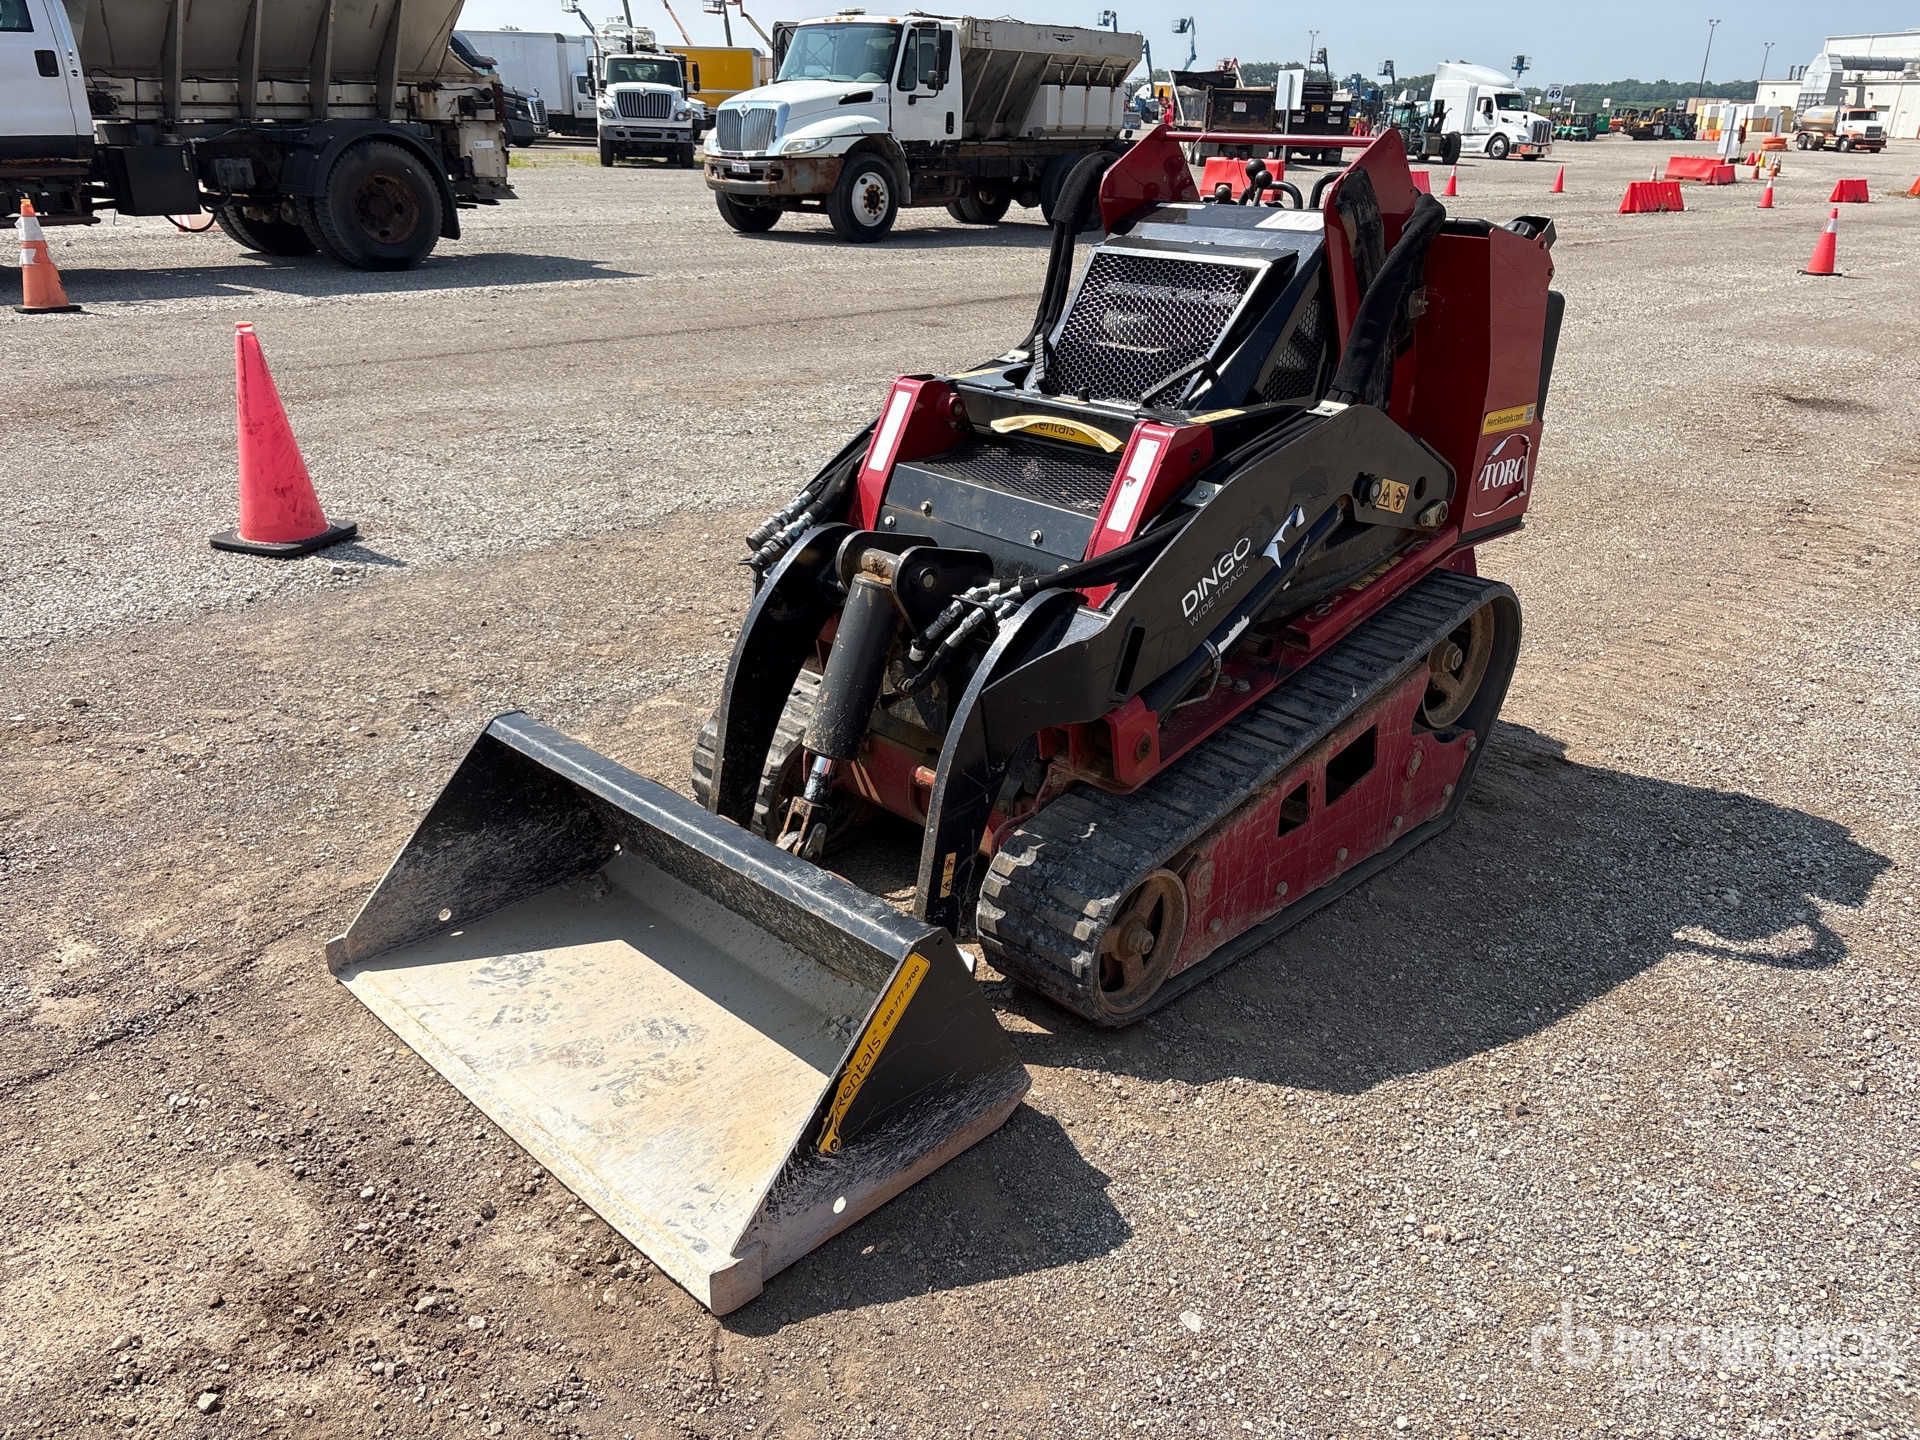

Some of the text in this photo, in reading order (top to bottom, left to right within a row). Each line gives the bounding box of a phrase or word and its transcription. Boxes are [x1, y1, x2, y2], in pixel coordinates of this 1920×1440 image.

[1549, 89, 1562, 99] 49
[1181, 537, 1251, 618] DINGO
[1189, 559, 1249, 627] WIDE TRACK
[882, 965, 920, 1028] 888-777-2700
